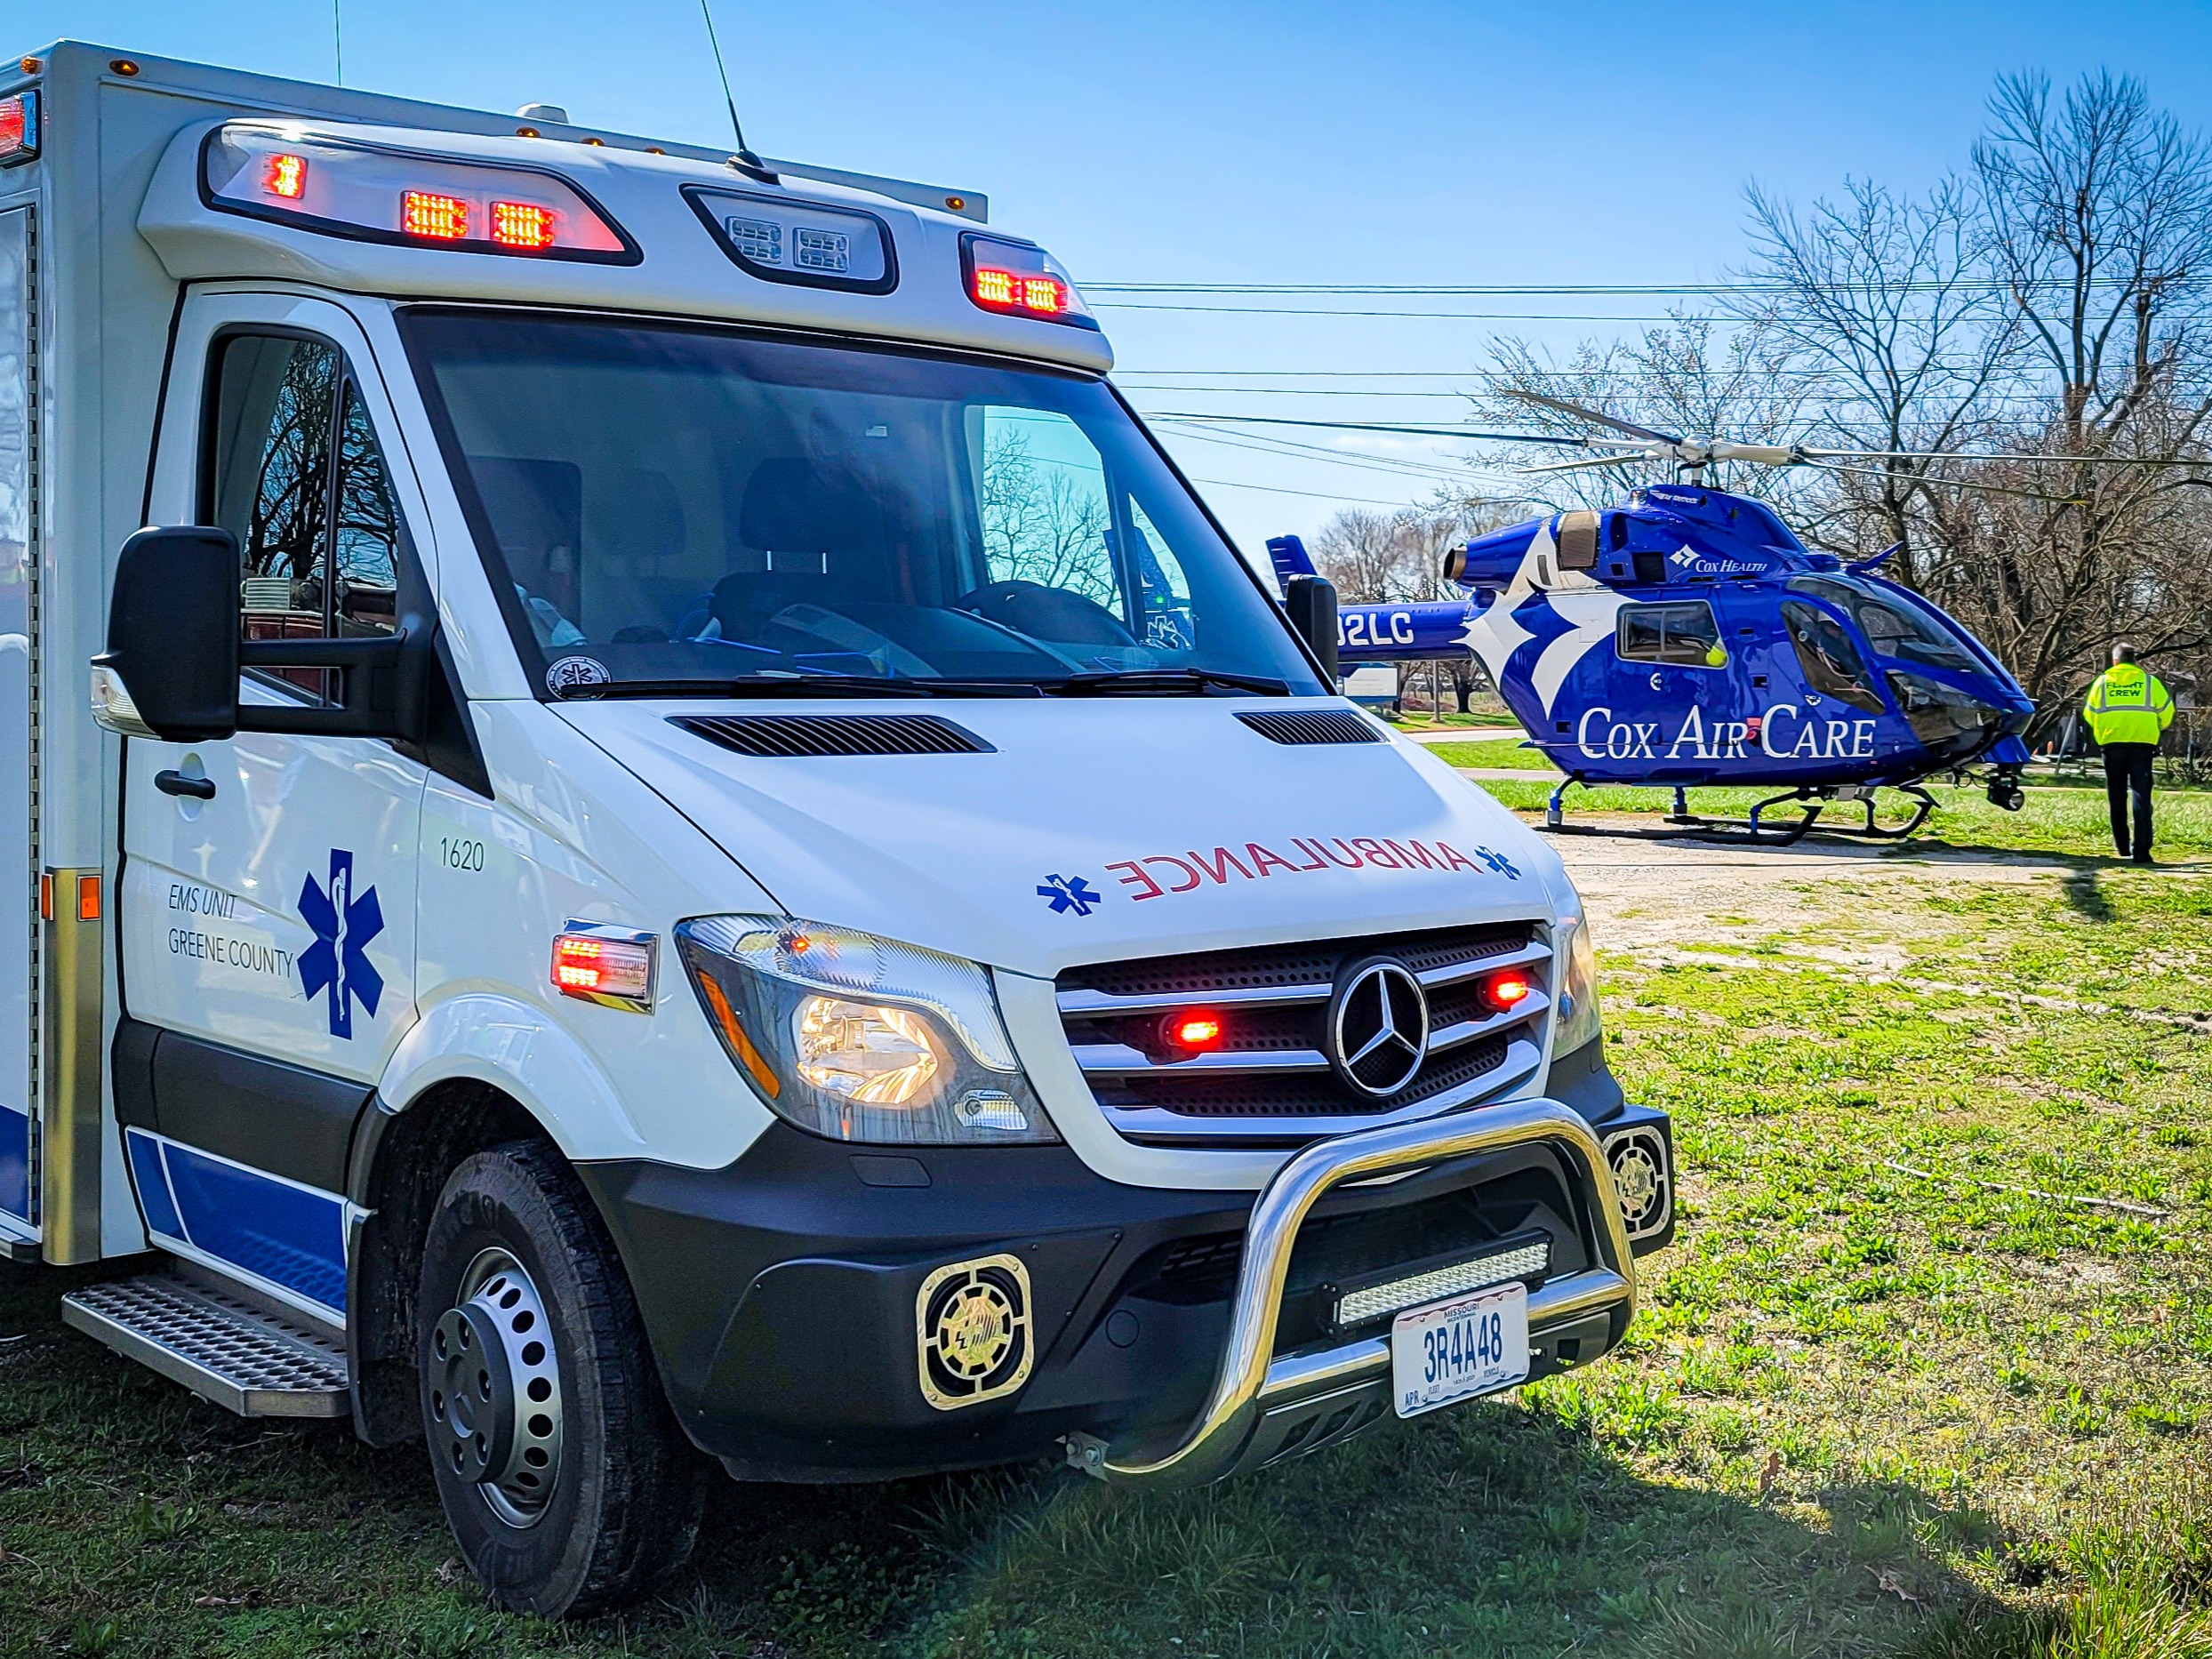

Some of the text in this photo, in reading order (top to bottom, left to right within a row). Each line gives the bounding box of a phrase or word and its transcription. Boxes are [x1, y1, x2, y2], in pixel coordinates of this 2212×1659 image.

[1695, 560, 1768, 573] COX HEALTH
[2109, 689, 2141, 697] CREW
[1578, 704, 1877, 759] COX AIR CARE
[440, 837, 485, 872] 1620
[169, 884, 237, 919] EMS UNIT
[168, 927, 294, 978] GREENE COUNTY
[1443, 1302, 1480, 1319] MISSOURI
[1423, 1311, 1503, 1383] 3R4A48
[1405, 1390, 1420, 1407] APR
